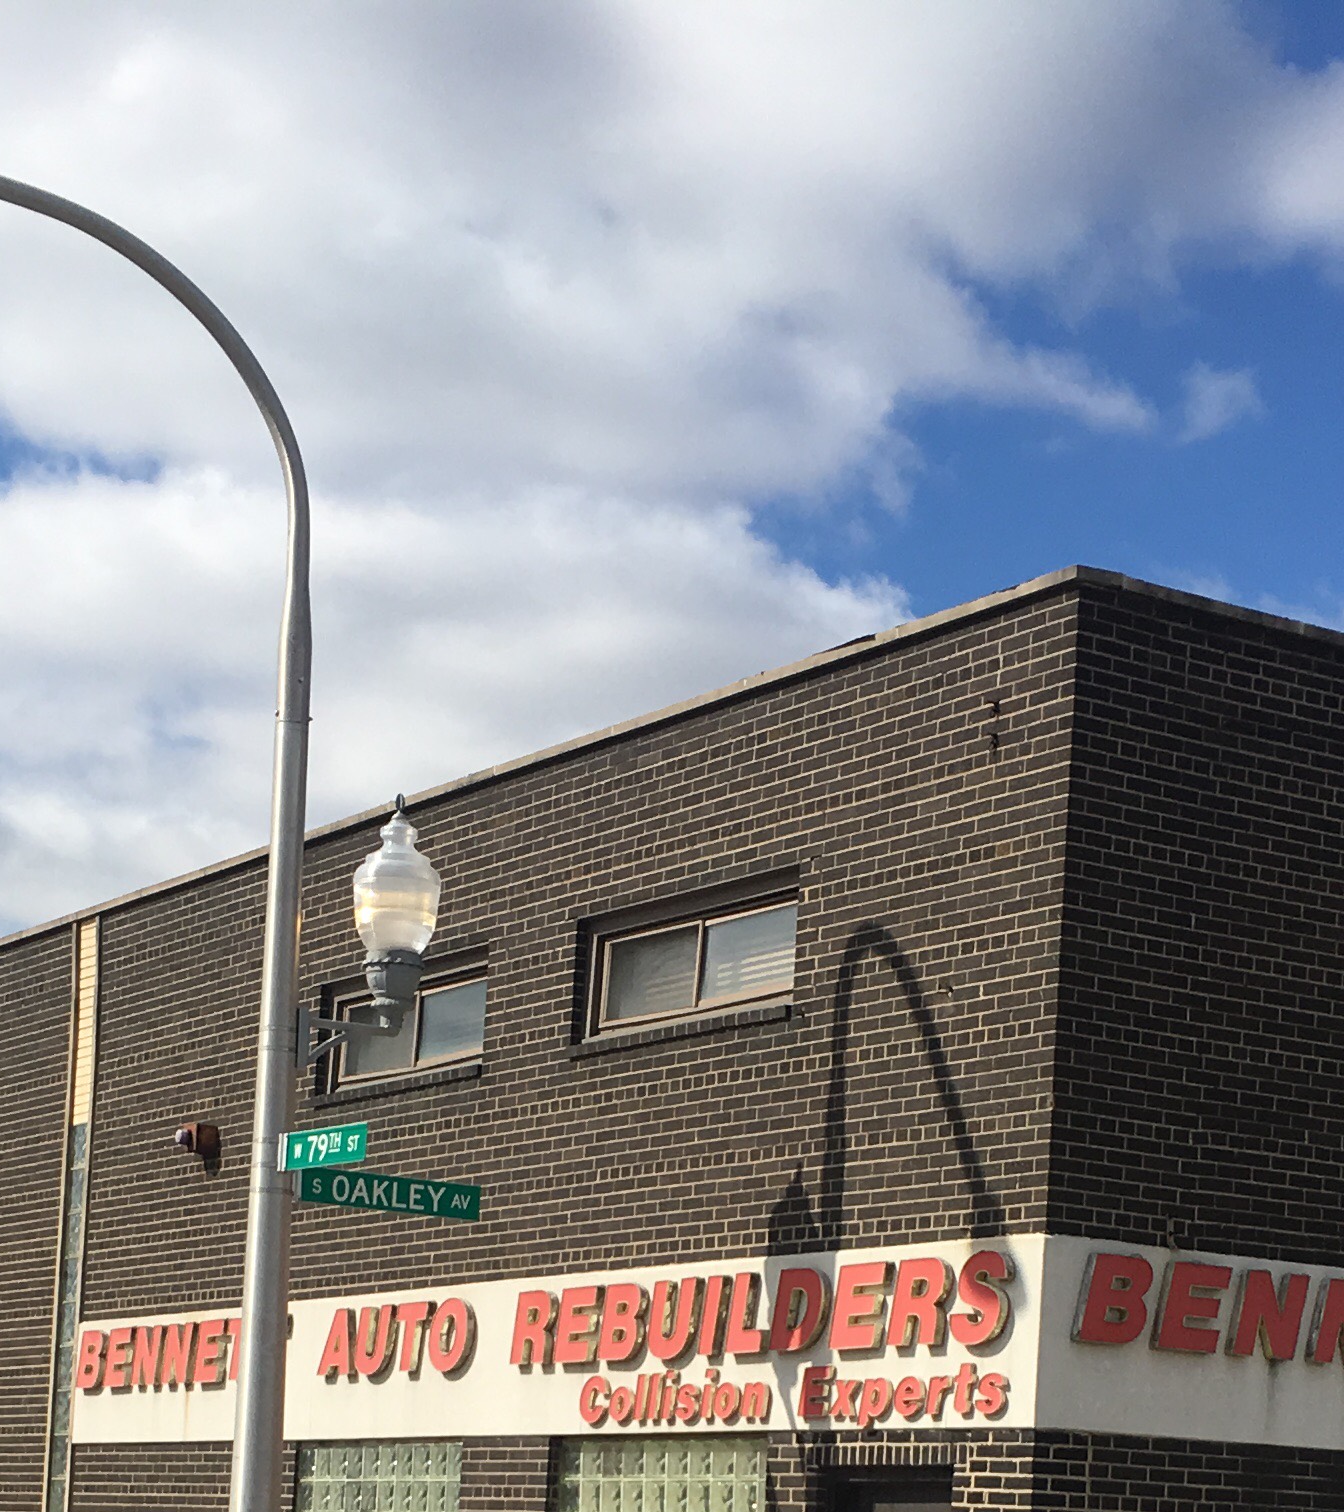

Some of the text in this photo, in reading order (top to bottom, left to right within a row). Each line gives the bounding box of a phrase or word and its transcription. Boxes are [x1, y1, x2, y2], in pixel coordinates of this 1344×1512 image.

[294, 1131, 360, 1163] W 79TH ST
[312, 1175, 471, 1212] S OAKLEY AV
[317, 1297, 475, 1381] AUTO
[510, 1249, 1014, 1366] REBUILDERS
[579, 1363, 1010, 1427] Collision Experts
